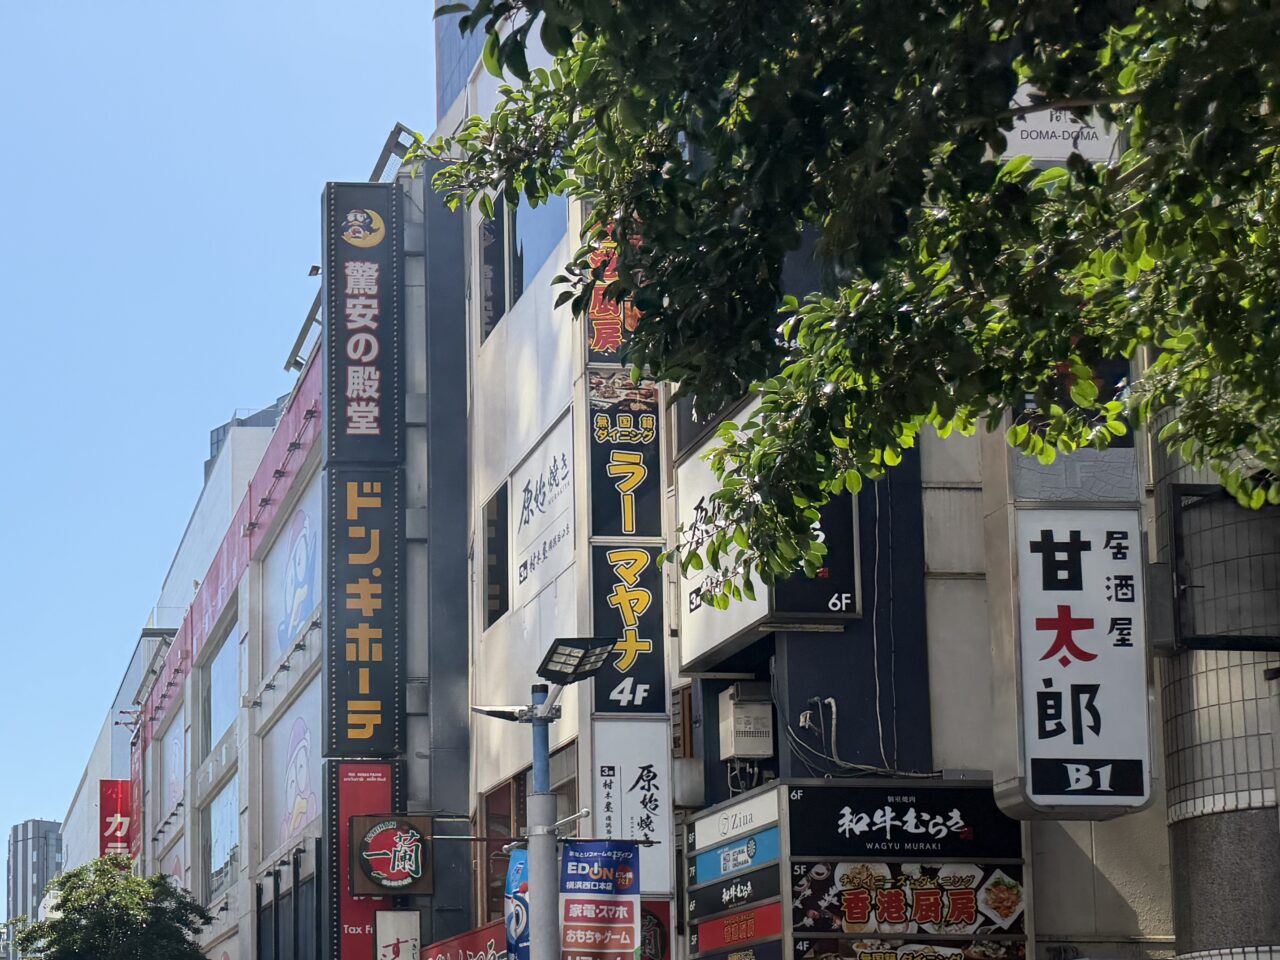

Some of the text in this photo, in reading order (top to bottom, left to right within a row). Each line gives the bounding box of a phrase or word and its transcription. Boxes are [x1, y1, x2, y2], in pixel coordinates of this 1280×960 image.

[1020, 130, 1099, 141] DOMA-DOMA
[344, 262, 380, 435] 驚安の殿堂
[595, 428, 656, 443] ダイニング
[518, 453, 569, 534] 原始焼き
[607, 451, 651, 673] ラーマヤナ
[1103, 531, 1135, 647] 居酒屋
[828, 593, 851, 611] 6F
[1030, 530, 1102, 744] 甘太郎
[609, 677, 650, 706] 4F
[1062, 763, 1113, 792] B1
[603, 779, 614, 813] 村木屋
[790, 790, 803, 799] 6F
[626, 764, 660, 848] 原始焼き
[731, 812, 754, 830] Zina
[837, 805, 968, 839] 和牛むらき
[363, 830, 422, 877] 一蘭
[866, 842, 942, 851] WAGYU MURAKI
[567, 862, 614, 880] EDION
[689, 866, 696, 877] 7F
[794, 865, 807, 875] 5F
[566, 881, 613, 891] 横浜西口本店
[569, 903, 628, 918] 家電・スマホ
[689, 900, 696, 911] 6F
[344, 924, 362, 934] Tax
[691, 935, 697, 945] 5F
[796, 941, 809, 950] 4F
